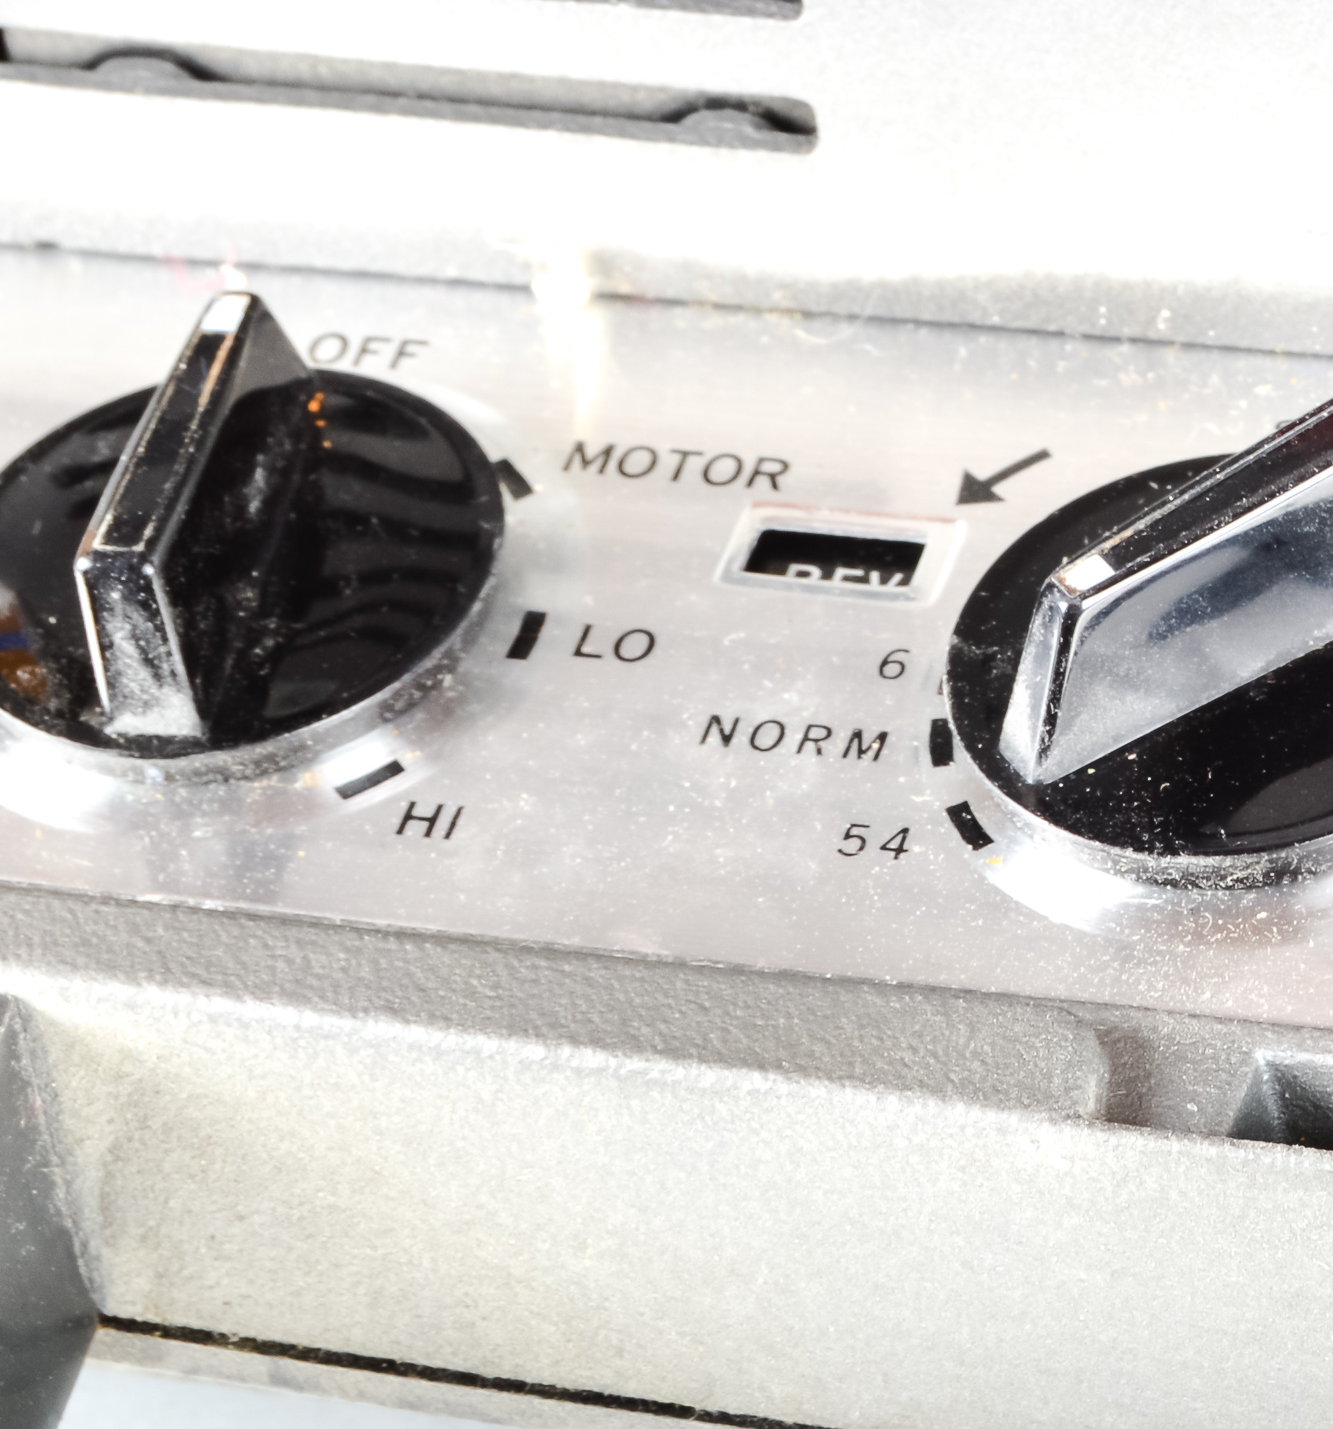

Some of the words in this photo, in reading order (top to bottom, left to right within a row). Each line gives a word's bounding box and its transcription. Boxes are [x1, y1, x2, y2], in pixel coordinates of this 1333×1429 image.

[308, 332, 429, 371] OFF
[563, 442, 789, 492] MOTOR
[573, 624, 655, 662] LO
[879, 649, 909, 679] 6
[700, 715, 888, 762] NORM
[396, 802, 463, 839] HI
[838, 823, 912, 862] 54
